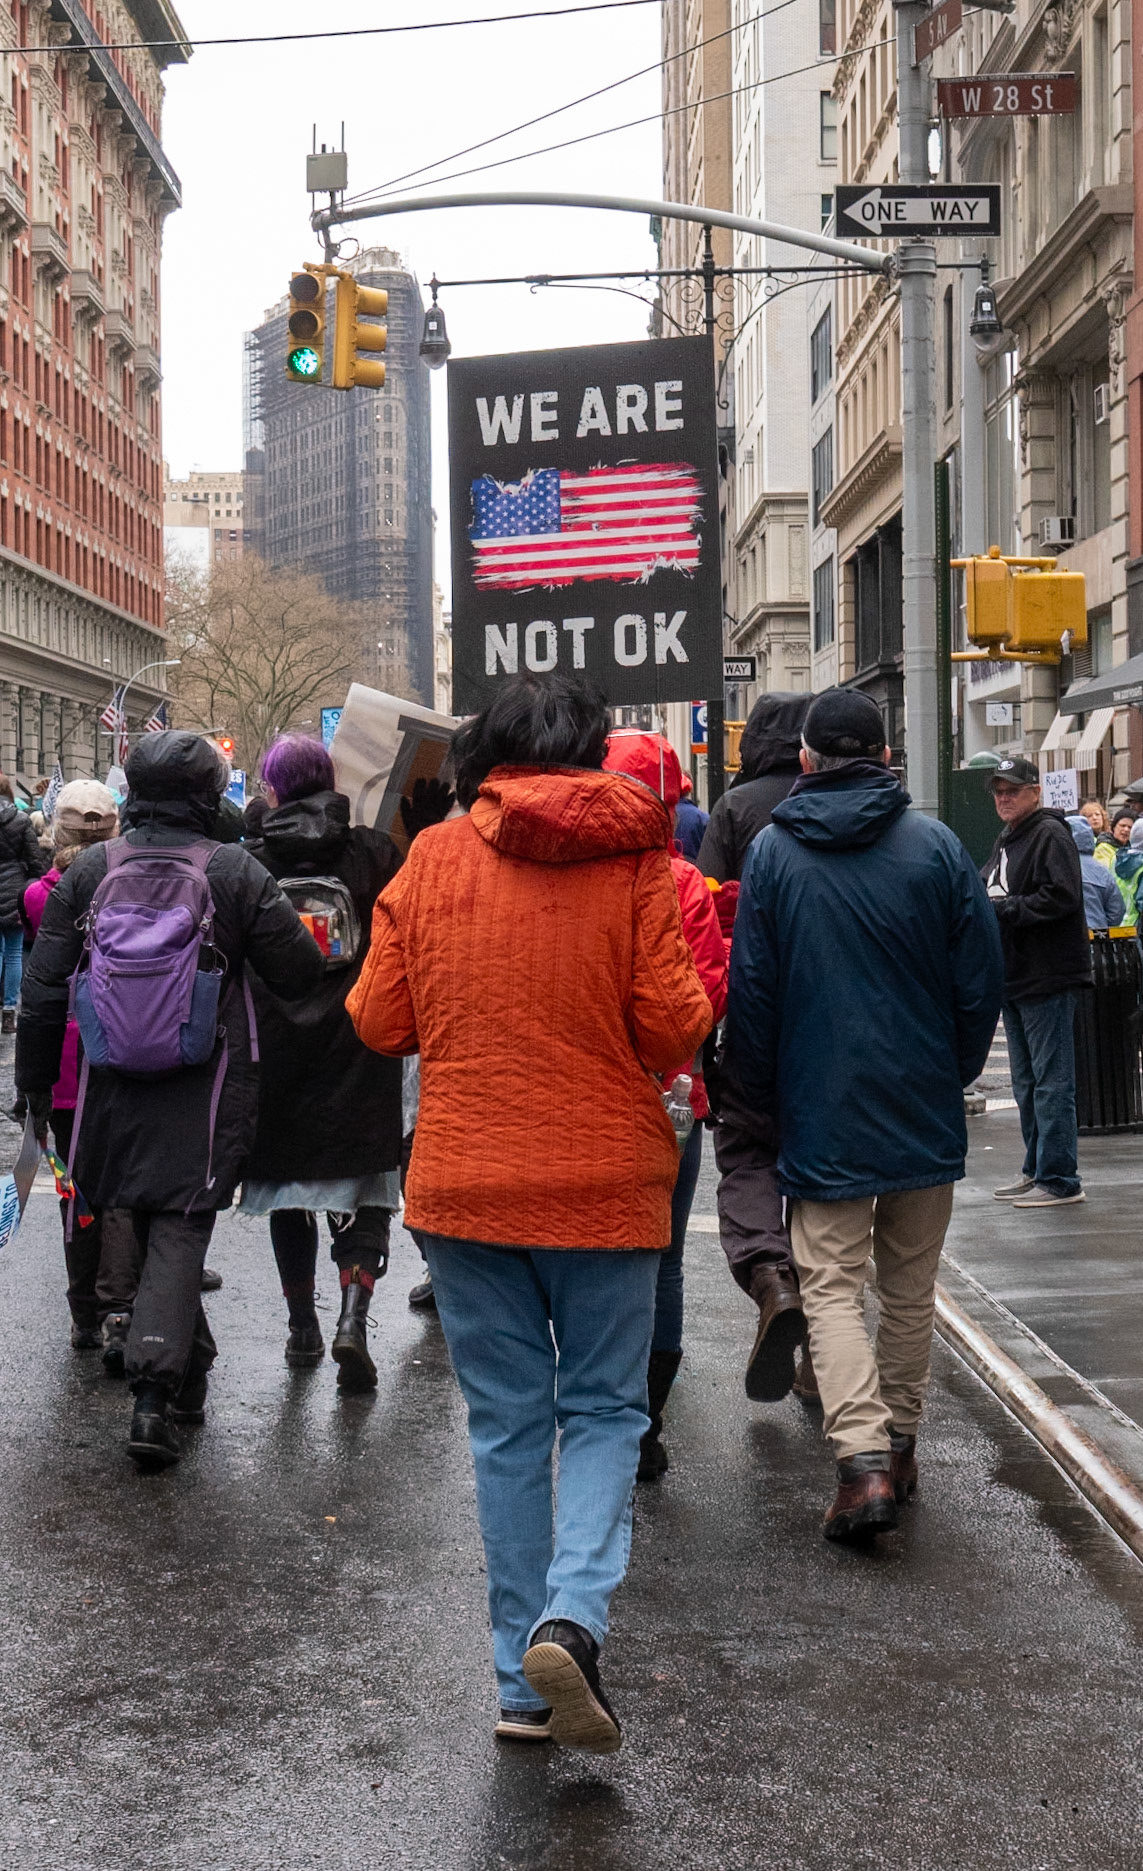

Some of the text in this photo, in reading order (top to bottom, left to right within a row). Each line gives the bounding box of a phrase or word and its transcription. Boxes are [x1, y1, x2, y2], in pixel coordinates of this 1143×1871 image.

[929, 20, 934, 47] 5
[962, 84, 1054, 113] W 28 St
[861, 201, 979, 221] ONE WAY
[475, 380, 684, 446] WE ARE
[484, 610, 690, 676] NOT OK
[725, 664, 748, 674] WAY
